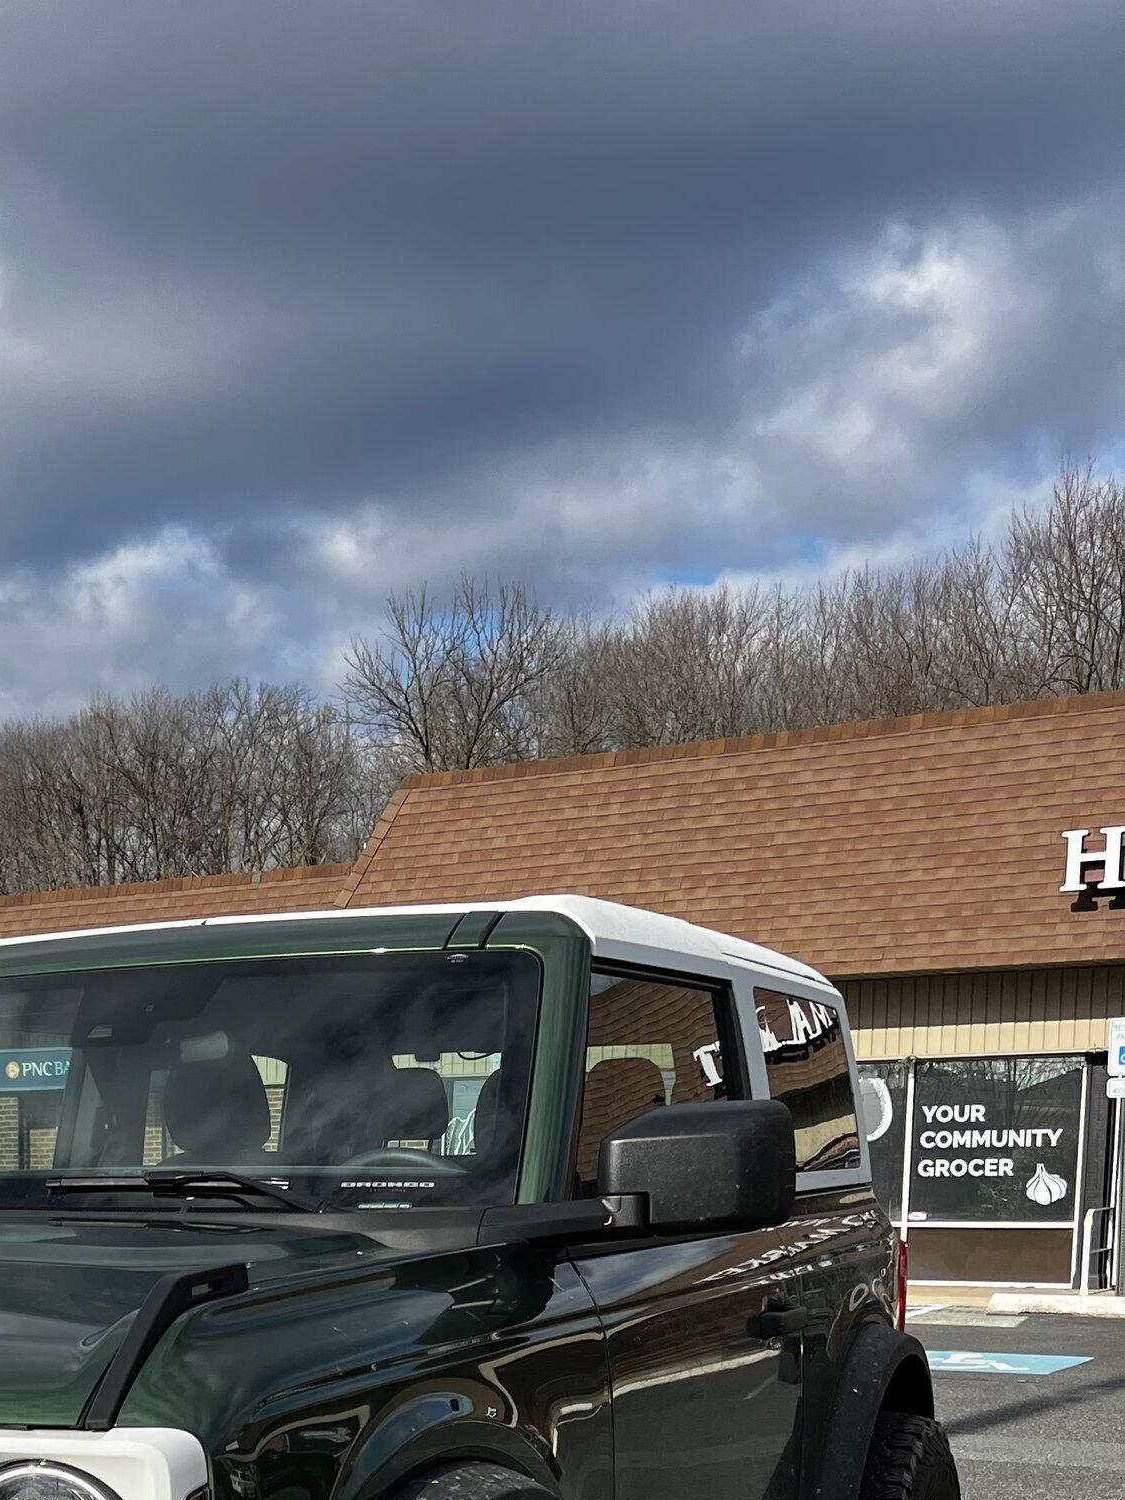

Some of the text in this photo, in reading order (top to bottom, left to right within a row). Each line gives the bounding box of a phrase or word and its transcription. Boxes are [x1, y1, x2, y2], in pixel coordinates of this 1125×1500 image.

[22, 1061, 53, 1077] PNC
[921, 1104, 986, 1124] YOUR
[919, 1128, 1064, 1149] COMMUNITY
[917, 1158, 1014, 1178] GROCER
